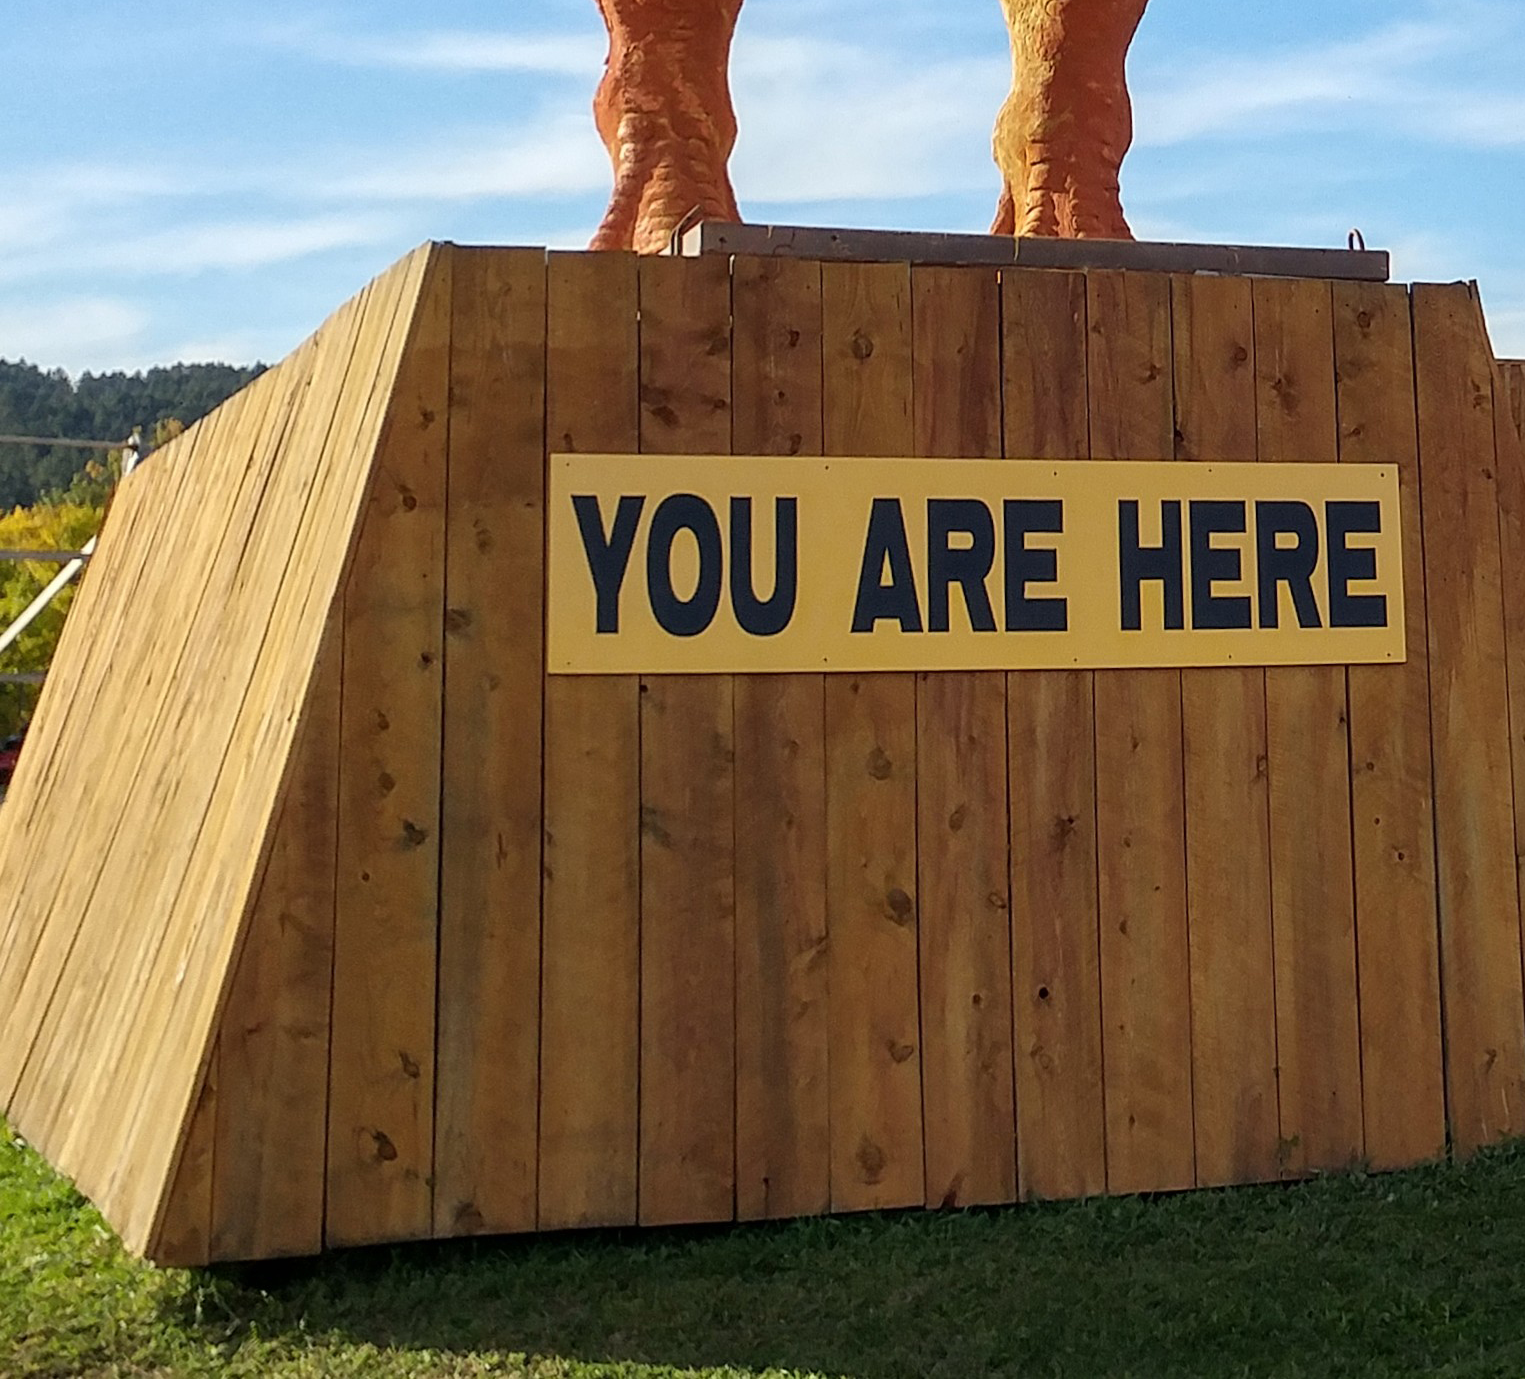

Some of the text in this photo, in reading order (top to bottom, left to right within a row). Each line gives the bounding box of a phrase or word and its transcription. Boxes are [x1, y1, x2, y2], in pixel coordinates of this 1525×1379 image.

[570, 493, 1389, 638] YOU ARE HERE
